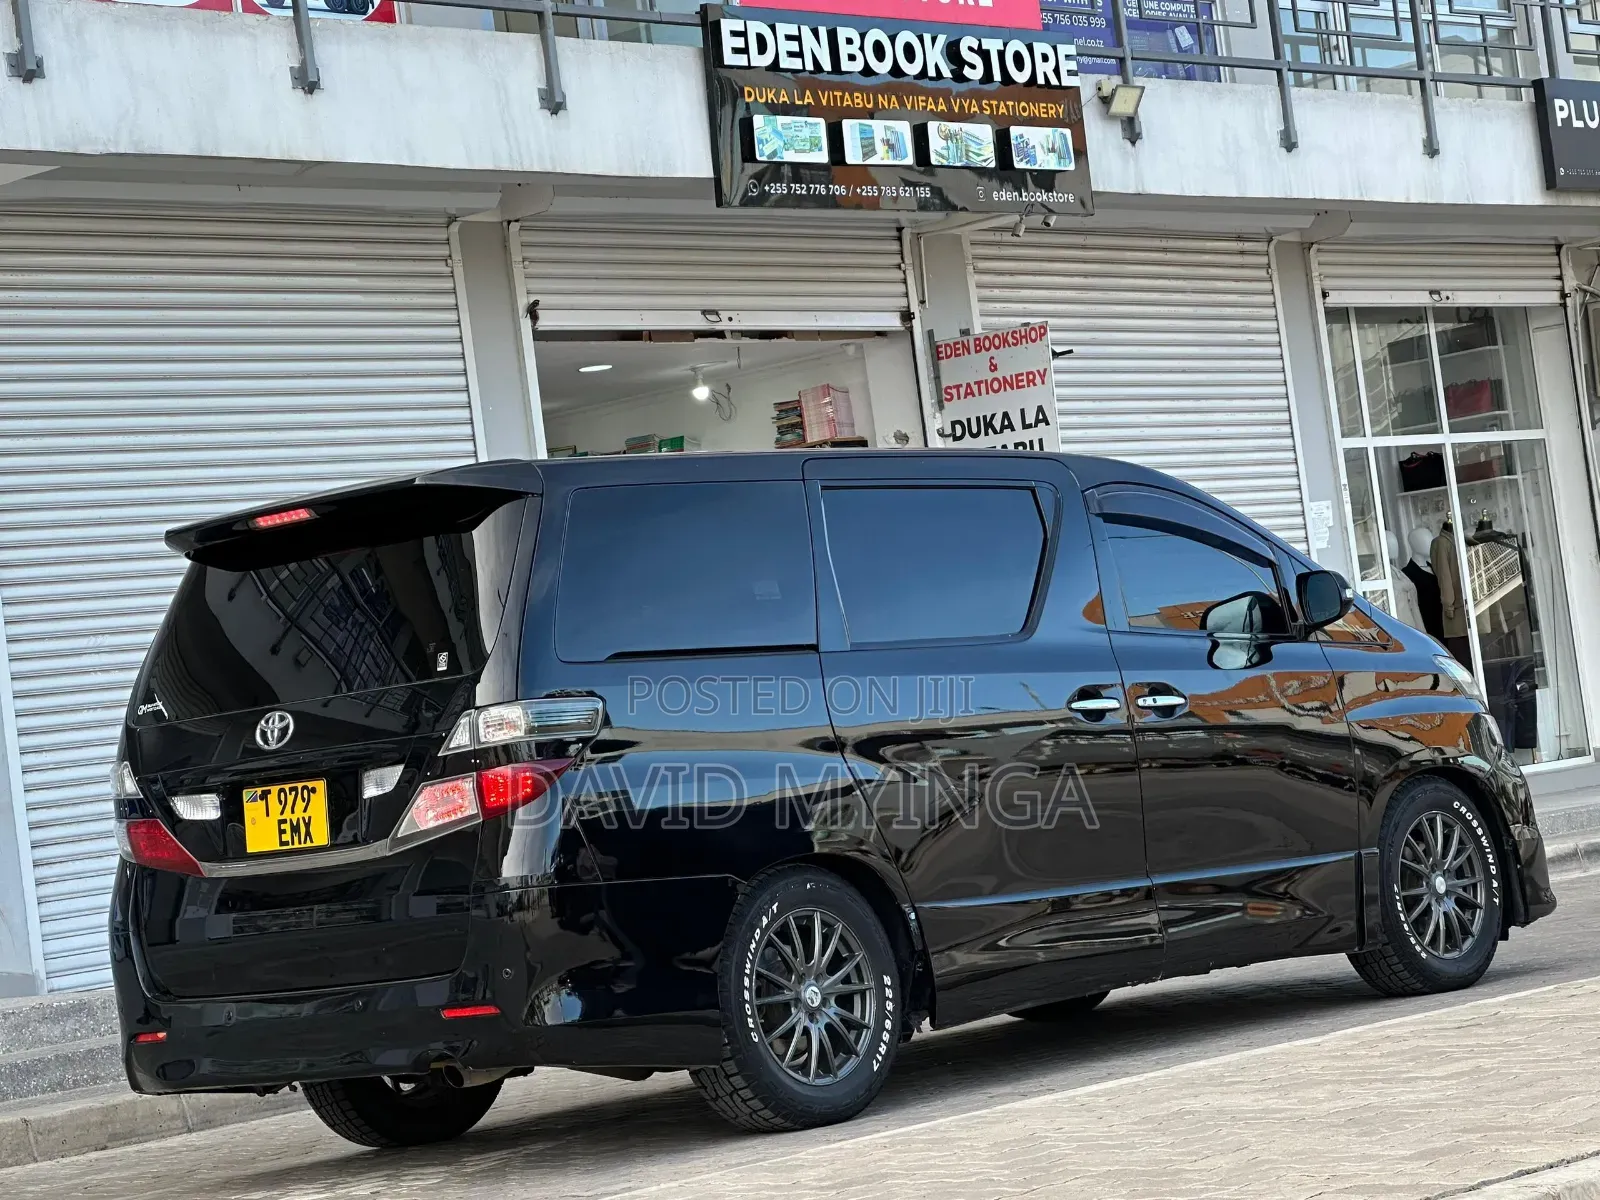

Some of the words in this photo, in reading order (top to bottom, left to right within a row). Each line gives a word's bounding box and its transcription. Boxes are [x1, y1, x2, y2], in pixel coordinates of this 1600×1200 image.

[1054, 14, 1070, 25] 756
[1072, 15, 1088, 27] 035
[1089, 16, 1106, 28] 999
[720, 19, 832, 72] EDEN
[838, 27, 952, 78] BOOK
[959, 35, 1080, 87] STORE
[743, 86, 790, 104] DUKA
[794, 89, 815, 106] LA
[818, 90, 873, 109] VITABU
[877, 93, 900, 110] NA
[903, 95, 947, 113] VIFAA
[950, 97, 980, 114] VYA
[982, 99, 1065, 119] STATIONERY
[764, 183, 787, 194] +255
[790, 183, 807, 195] 752
[809, 184, 826, 195] 776
[829, 184, 846, 196] 706
[856, 185, 878, 197] +255
[881, 186, 897, 197] 785
[899, 186, 914, 198] 621
[915, 187, 931, 198] 155
[992, 188, 1075, 203] eden.bookstore
[936, 339, 971, 361] EDEN
[973, 324, 1048, 354] BOOKSHOP
[988, 356, 998, 373] &
[943, 368, 1048, 403] STATIONERY
[950, 410, 1016, 442] DUKA
[1019, 404, 1050, 430] LA
[260, 789, 272, 818] T
[277, 784, 311, 816] 979
[278, 816, 314, 848] EMX
[1453, 801, 1497, 875] CROSSWIND
[1491, 878, 1500, 906] A/T
[743, 928, 760, 1043] CROSSWIND
[761, 902, 779, 929] A/T
[871, 974, 894, 1072] 225/65R17
